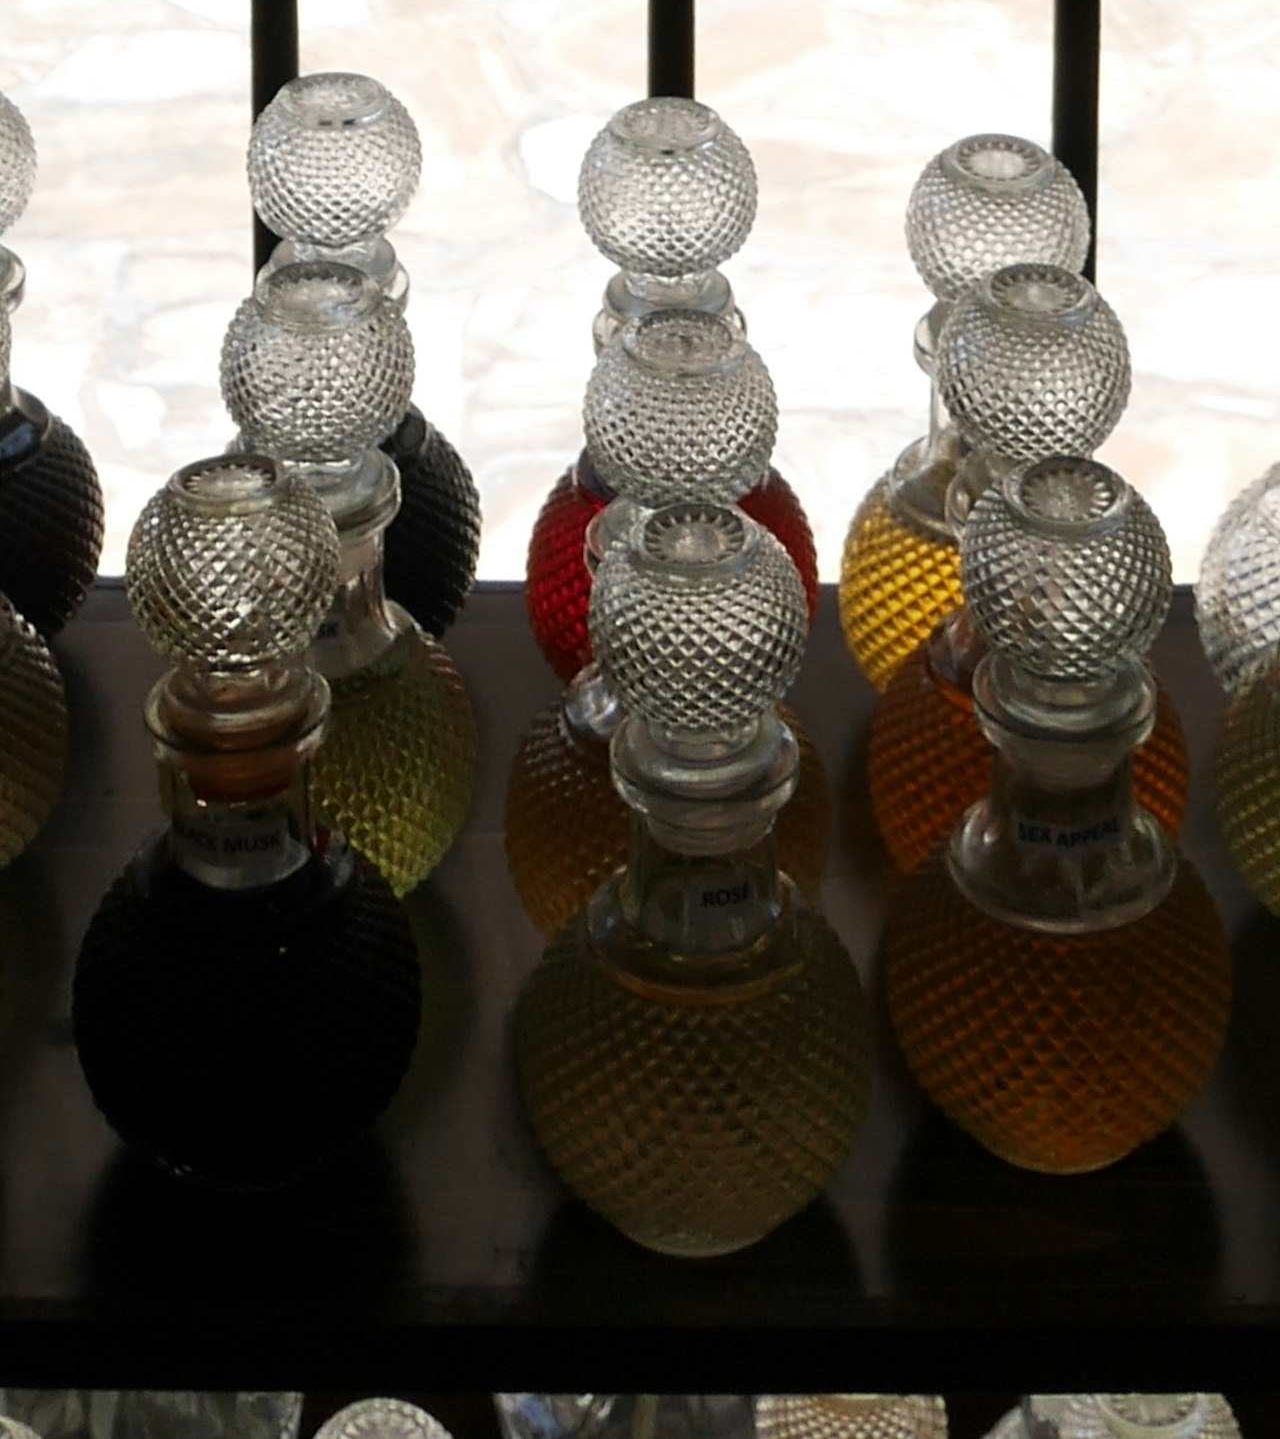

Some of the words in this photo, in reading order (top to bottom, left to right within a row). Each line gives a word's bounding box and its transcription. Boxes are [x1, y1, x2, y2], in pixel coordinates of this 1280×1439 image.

[223, 832, 280, 853] MUSK
[1018, 822, 1053, 846] SEX
[1055, 817, 1120, 849] APPEAL
